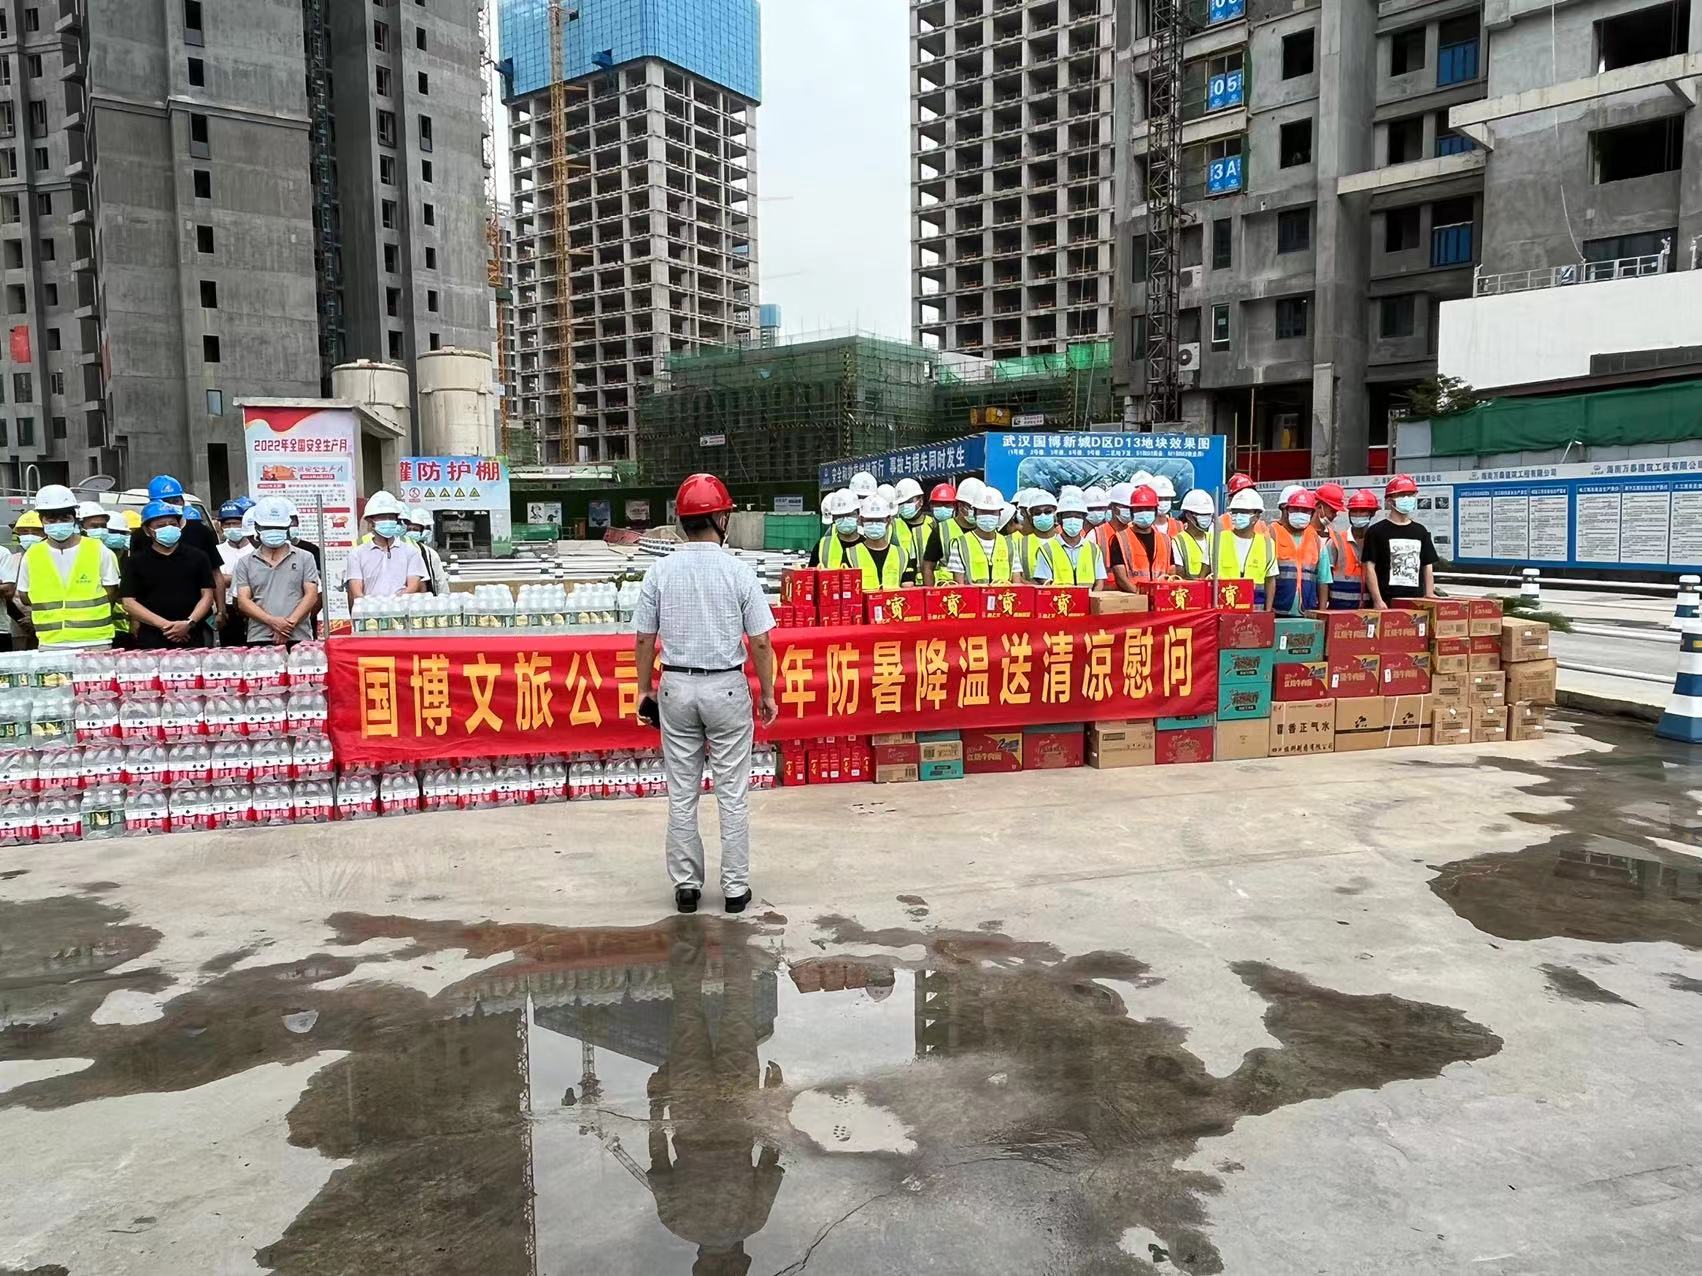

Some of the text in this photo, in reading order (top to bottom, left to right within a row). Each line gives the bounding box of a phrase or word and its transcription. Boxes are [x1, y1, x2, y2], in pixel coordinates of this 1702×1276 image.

[1214, 76, 1237, 95] 05
[1214, 160, 1237, 179] 3A
[254, 438, 348, 452] 2022年全国安全生产月
[1002, 435, 1210, 449] 武汉国博新城D区D13地块效果图
[889, 445, 966, 474] 事故与损失同时发生
[358, 625, 1193, 739] 国博文旅公司年防暑降温送清凉慰问
